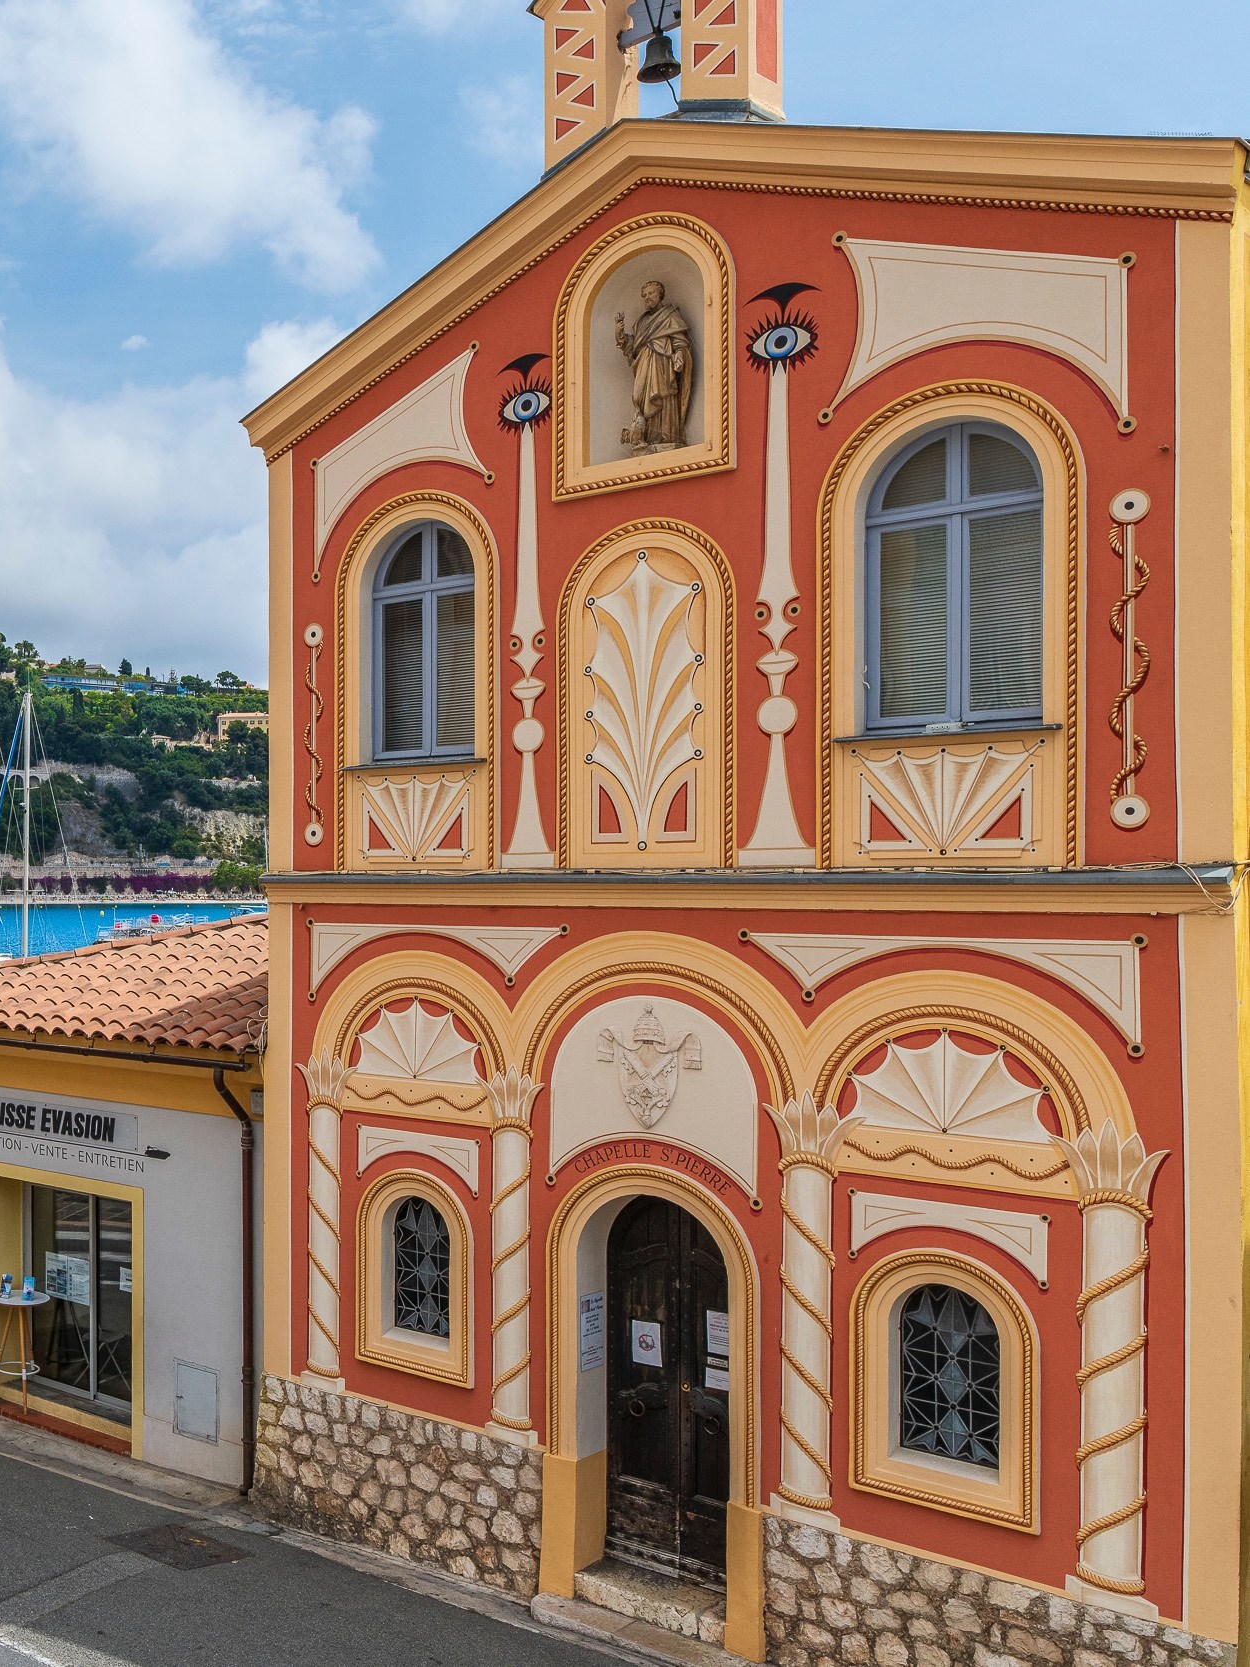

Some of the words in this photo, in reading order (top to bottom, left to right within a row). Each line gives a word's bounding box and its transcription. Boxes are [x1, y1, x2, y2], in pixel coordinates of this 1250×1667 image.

[40, 1107, 116, 1143] EVASION
[31, 1142, 68, 1160] VENTE
[78, 1150, 145, 1173] ENTRETIEN
[574, 1143, 651, 1174] CHAPELLE
[675, 1153, 732, 1196] PIERRE
